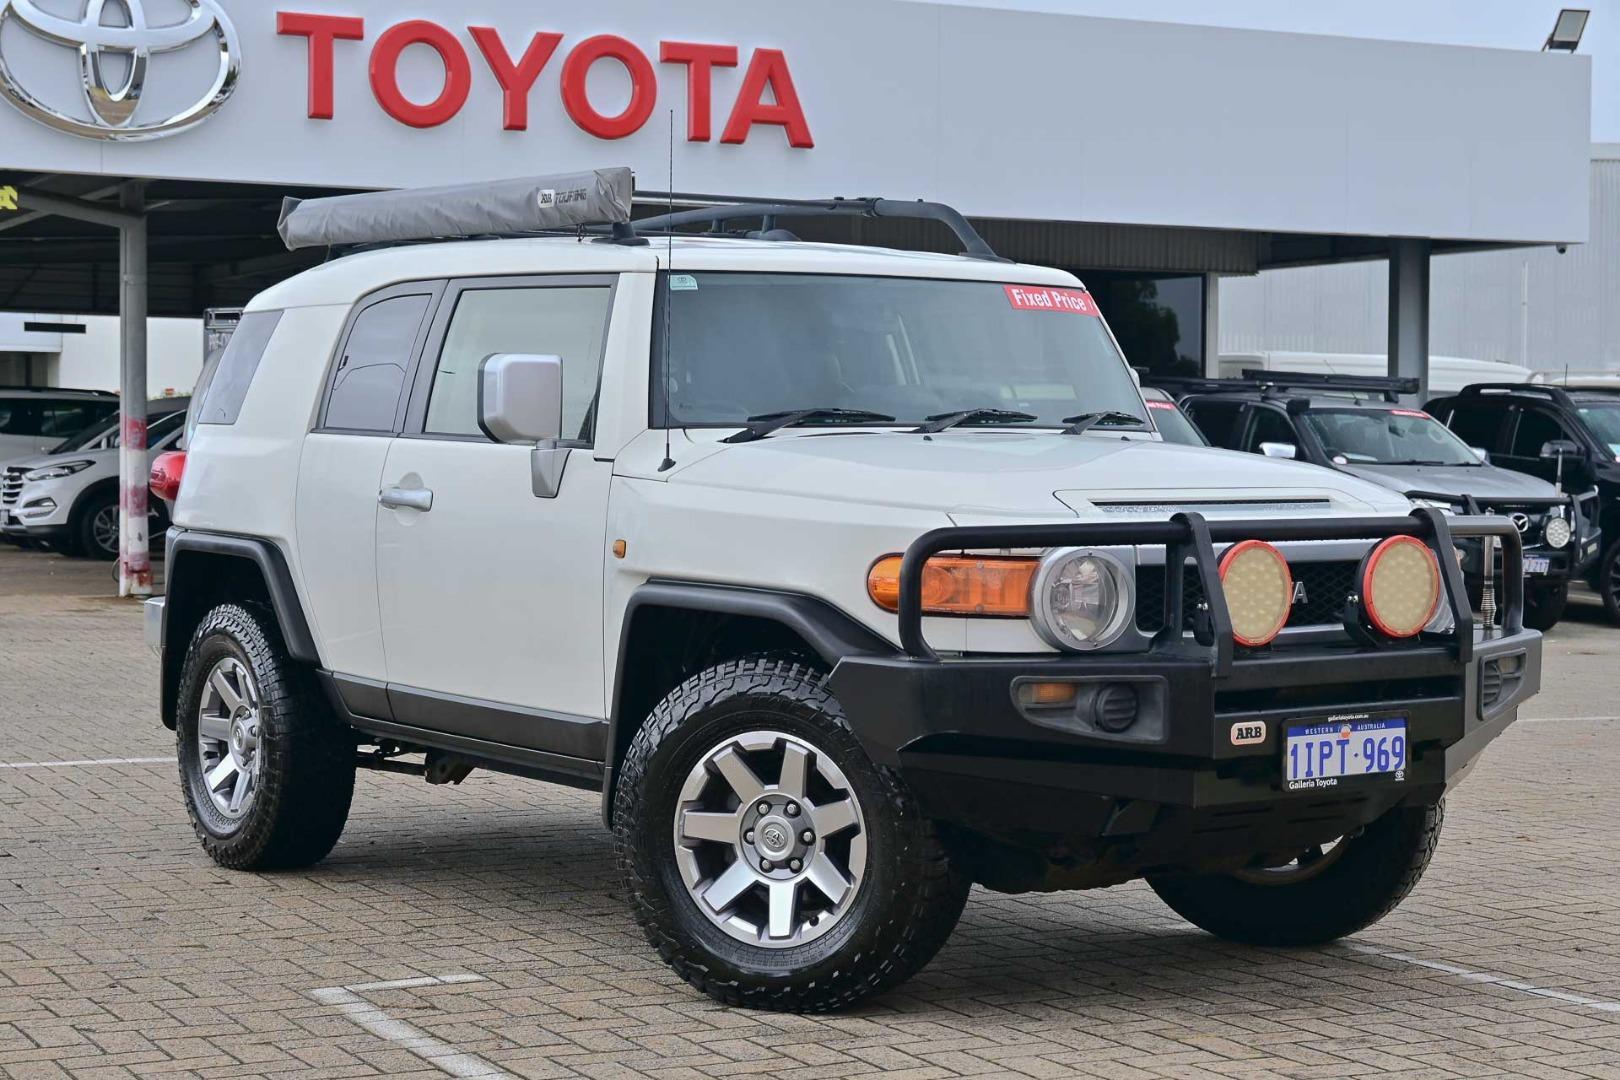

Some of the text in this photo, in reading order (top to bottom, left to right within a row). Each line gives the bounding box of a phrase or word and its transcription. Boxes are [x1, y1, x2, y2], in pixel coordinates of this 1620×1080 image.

[277, 11, 814, 149] TOYOTA
[1011, 288, 1053, 307] Fixed
[1051, 291, 1087, 311] Price
[1236, 726, 1262, 740] ARB
[1305, 723, 1386, 735] WESTERN AUSTRALIA
[1289, 777, 1338, 790] Galleria Toyota
